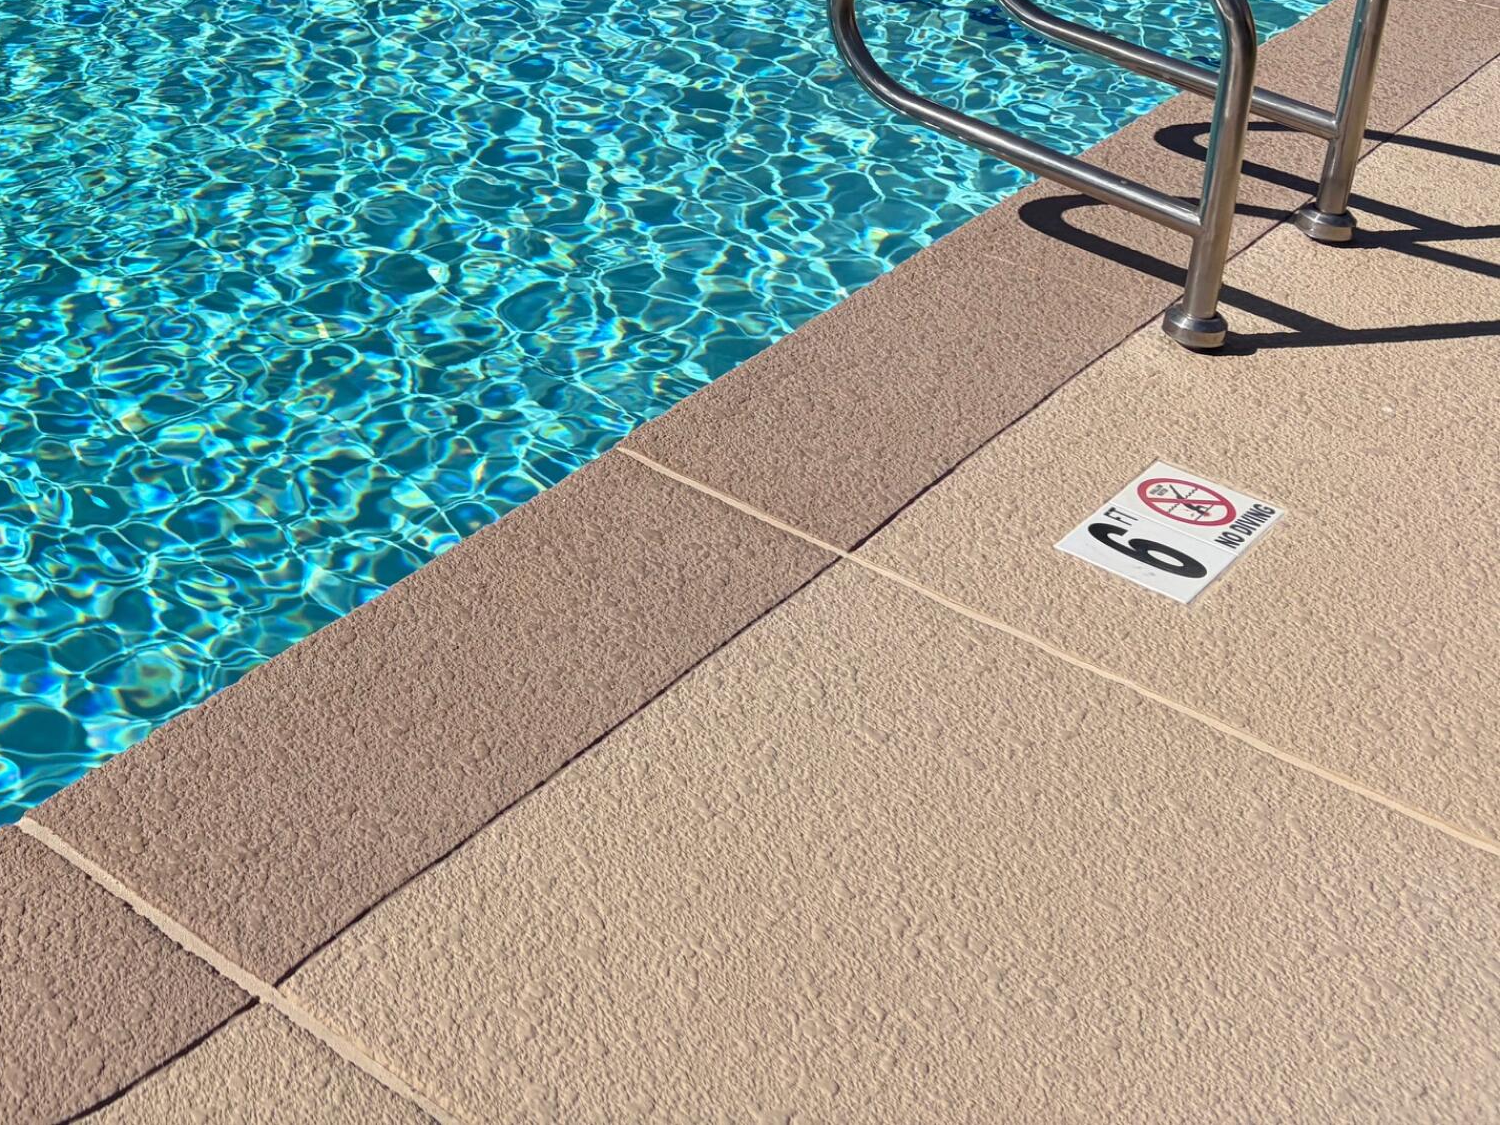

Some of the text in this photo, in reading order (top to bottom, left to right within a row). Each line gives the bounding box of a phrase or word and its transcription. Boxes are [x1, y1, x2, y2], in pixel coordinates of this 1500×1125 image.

[1088, 507, 1207, 578] 6 FT
[1214, 503, 1276, 550] NO DIVING
